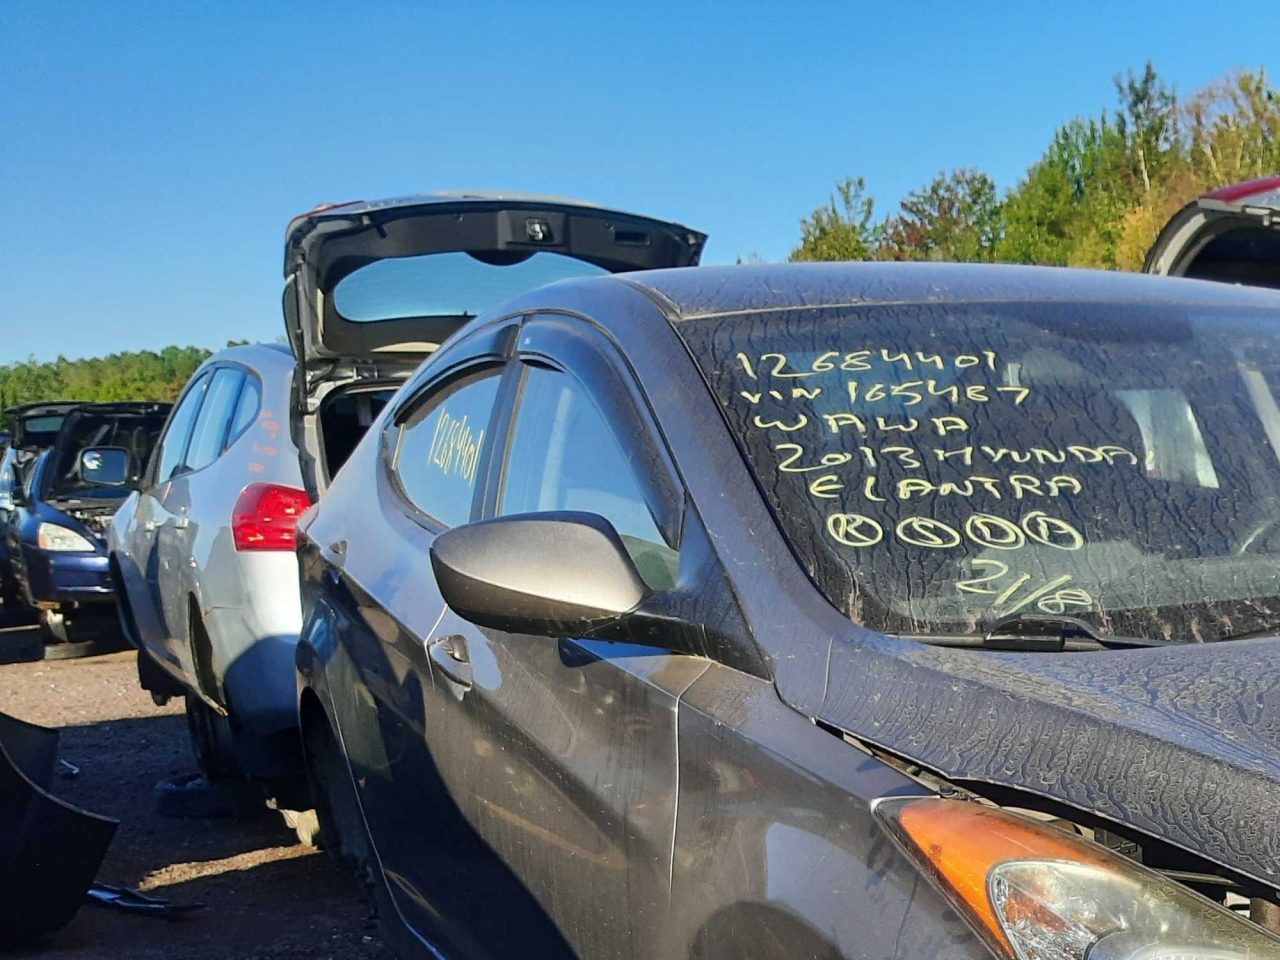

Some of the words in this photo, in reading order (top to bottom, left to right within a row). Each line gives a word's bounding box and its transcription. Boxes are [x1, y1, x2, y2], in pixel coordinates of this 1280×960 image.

[737, 349, 997, 380] 12684401
[740, 387, 822, 404] VIN
[774, 443, 922, 473] 2013
[809, 474, 1083, 501] ELANTRA
